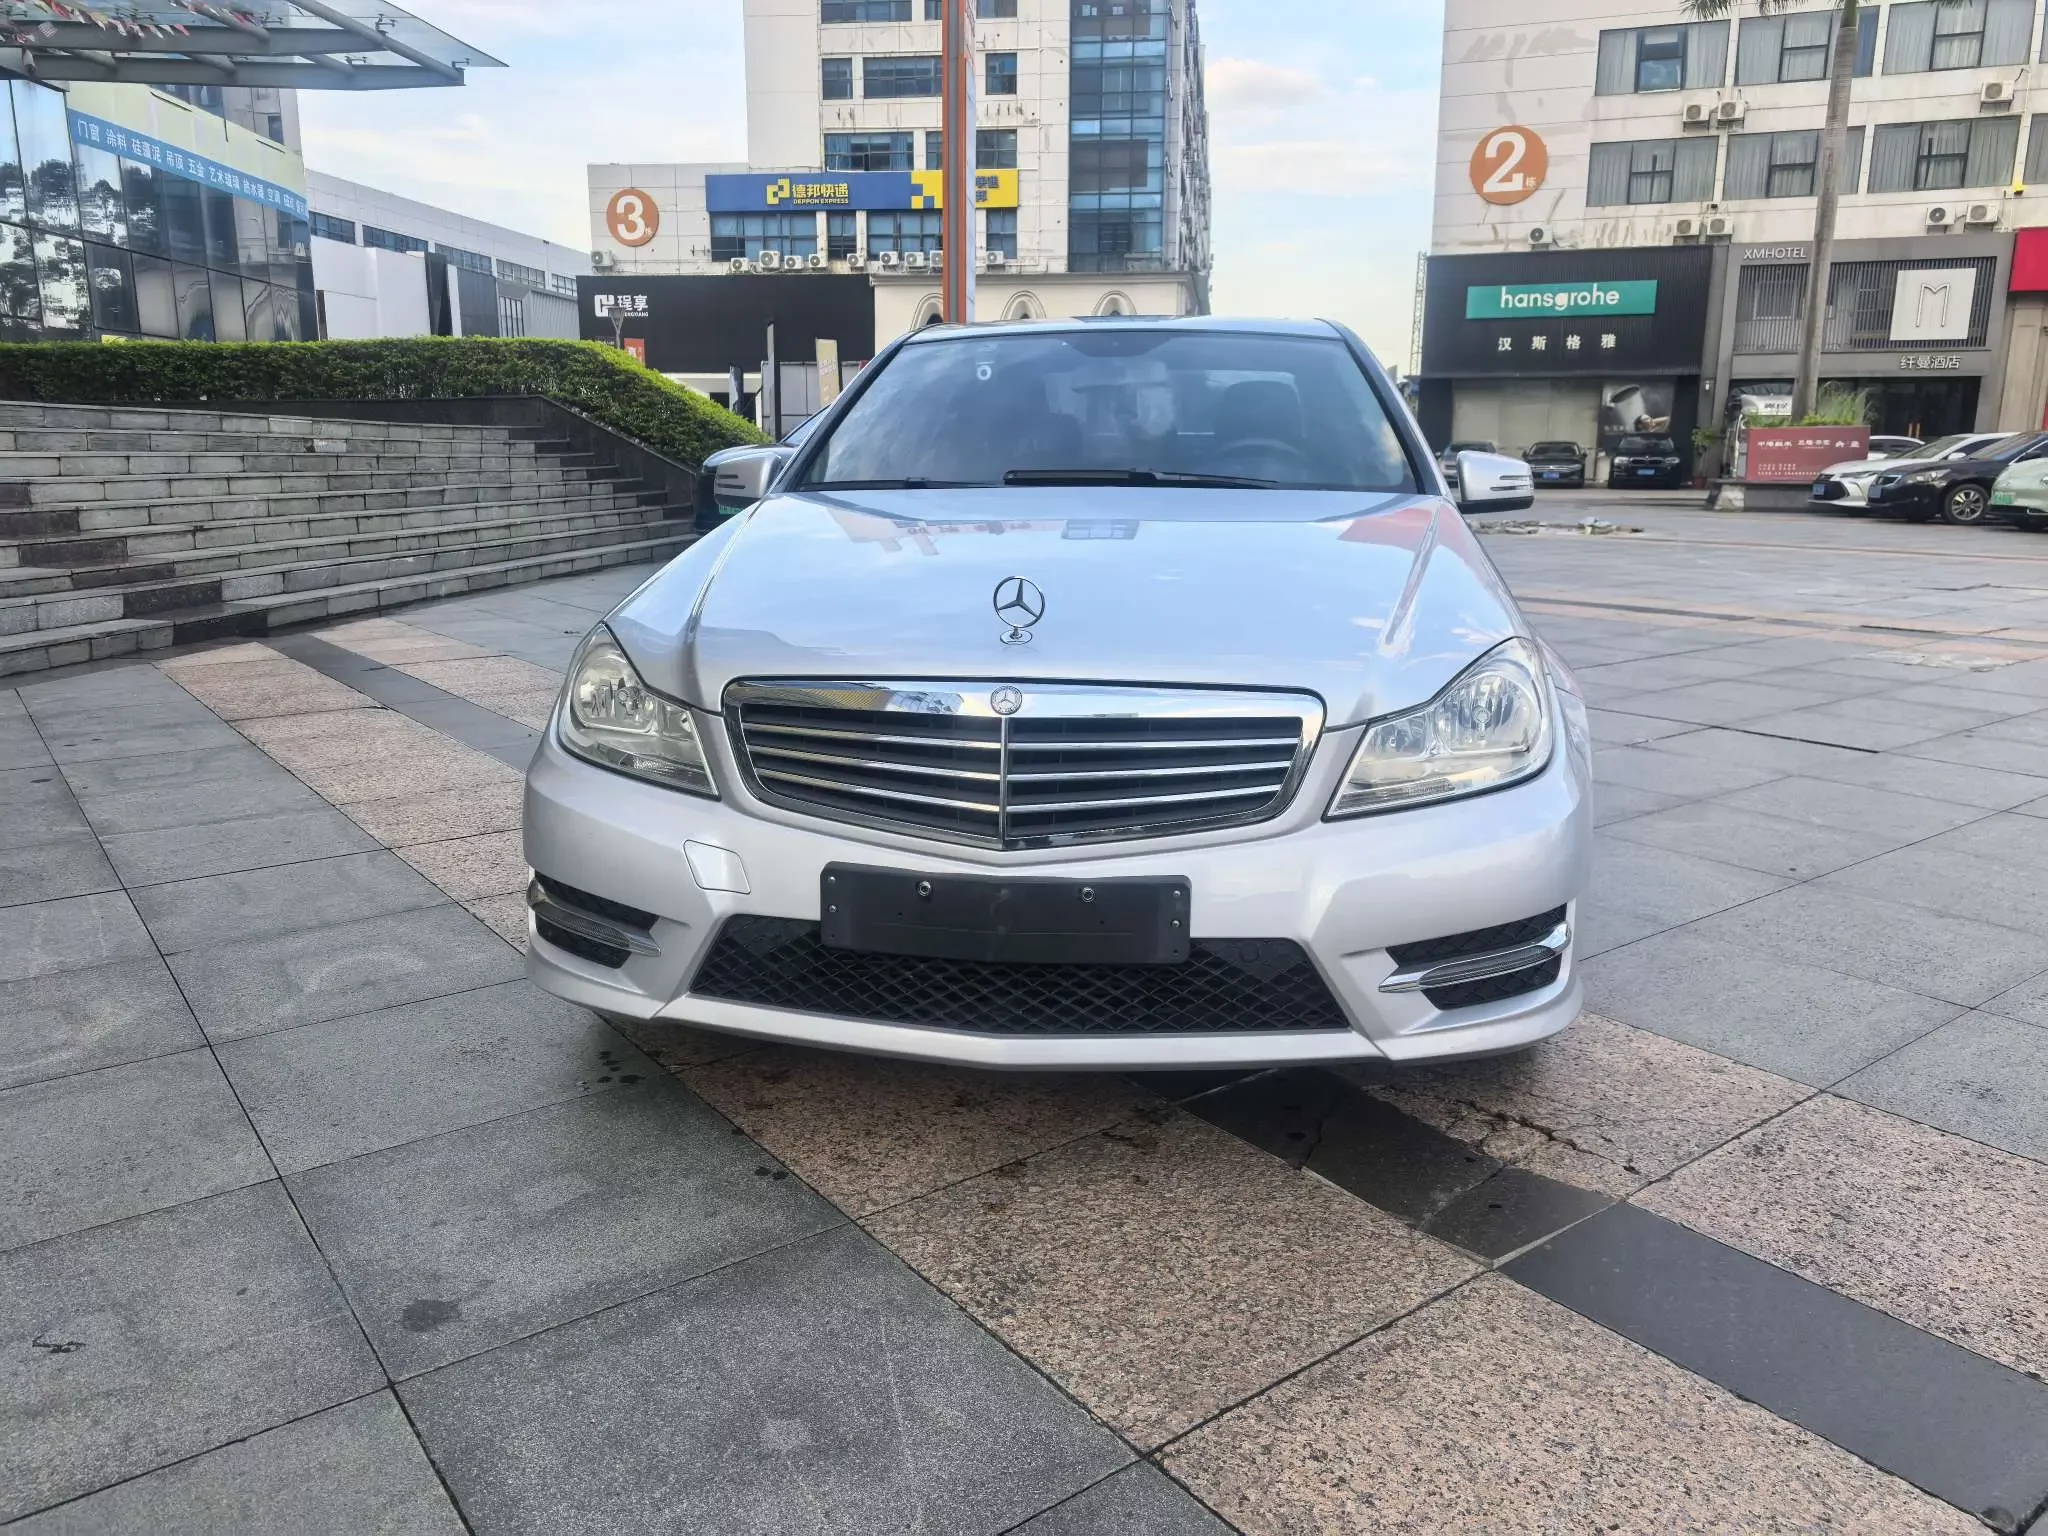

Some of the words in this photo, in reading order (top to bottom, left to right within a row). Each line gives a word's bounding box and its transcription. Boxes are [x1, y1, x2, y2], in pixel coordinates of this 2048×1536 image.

[78, 120, 99, 143] 门窗
[105, 128, 127, 151] 涂料
[166, 150, 184, 170] 吊顶
[188, 158, 205, 179] 五金
[792, 183, 849, 198] 德邦快递
[1743, 247, 1807, 259] XMHOTEL
[1500, 283, 1620, 311] hansgrohe
[1498, 333, 1617, 352] 汉斯格雅
[1900, 355, 1961, 370] 纤曼酒店
